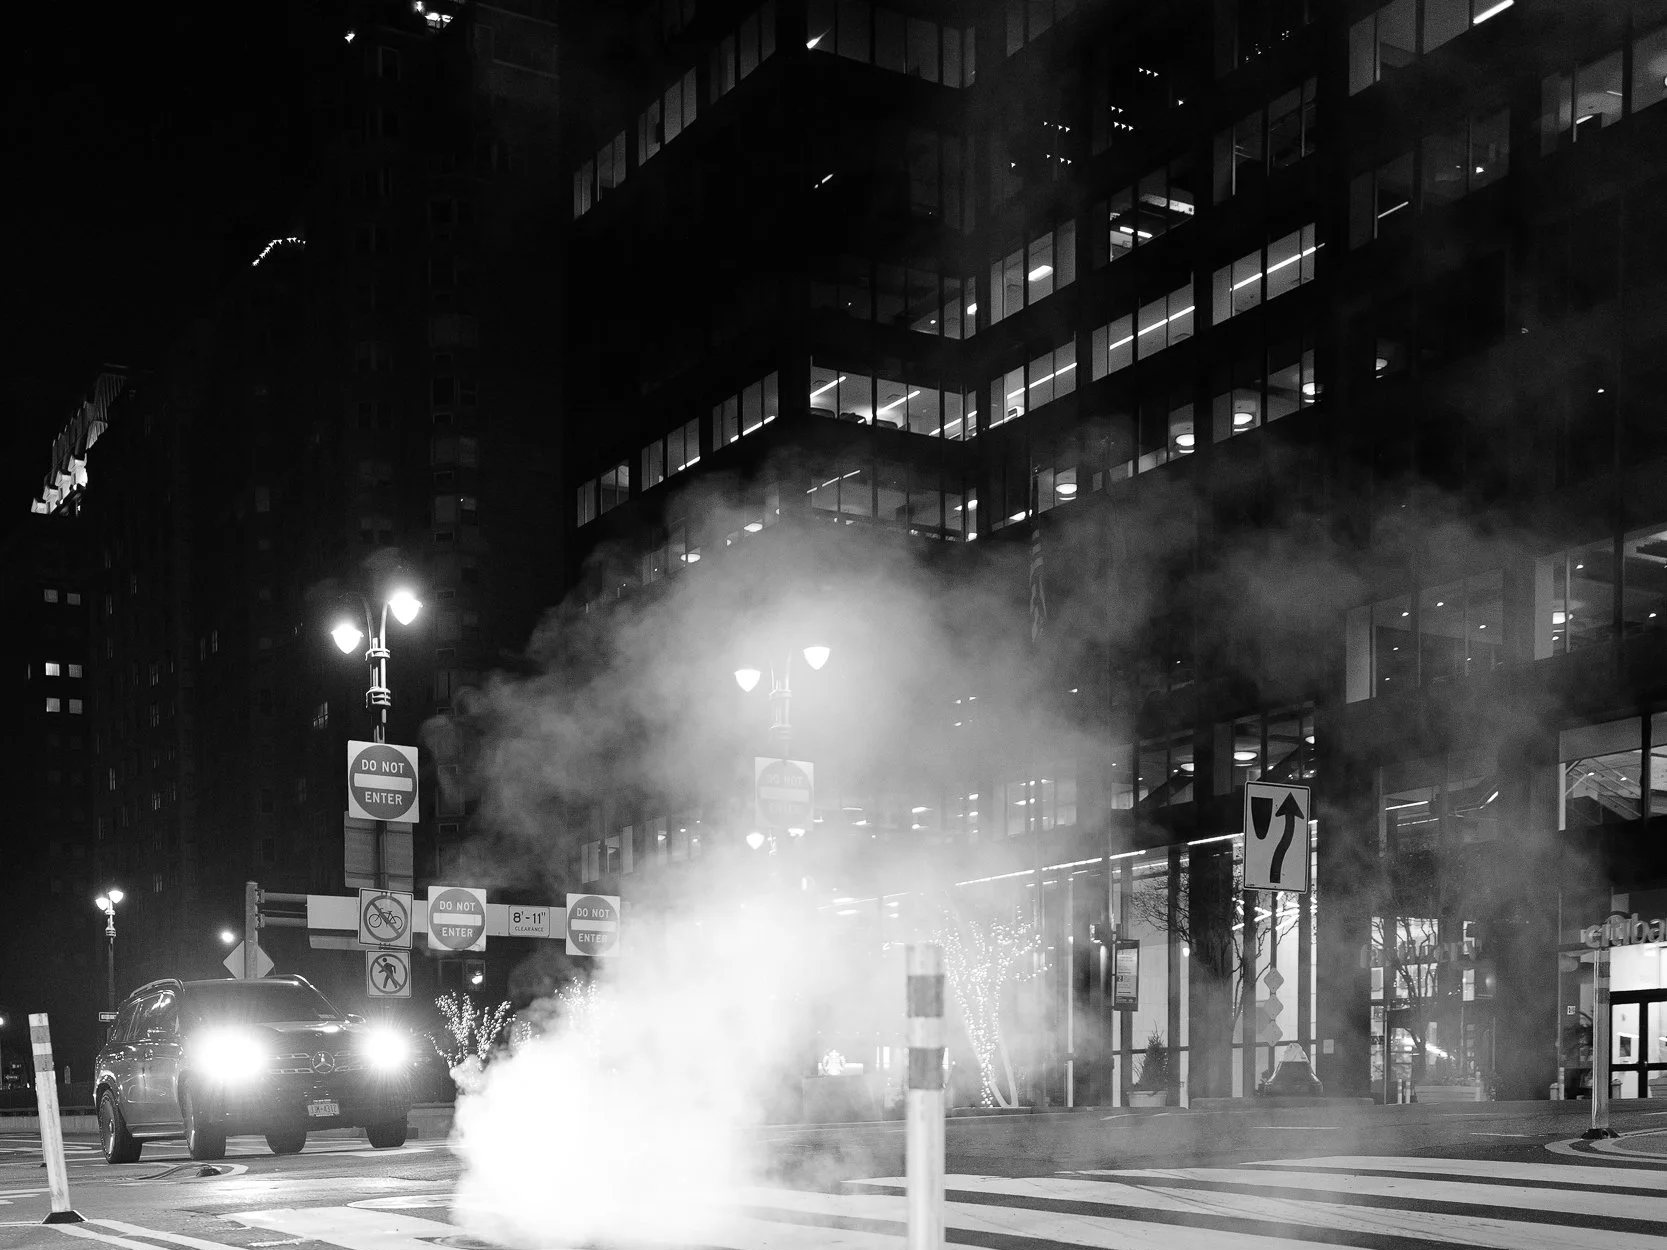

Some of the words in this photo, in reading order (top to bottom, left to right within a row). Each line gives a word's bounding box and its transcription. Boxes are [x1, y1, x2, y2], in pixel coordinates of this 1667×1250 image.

[361, 759, 377, 771] DO
[382, 761, 405, 774] NOT
[766, 774, 780, 784] DO
[784, 775, 804, 787] NOT
[365, 791, 403, 805] ENTER
[439, 901, 453, 911] DO
[456, 902, 476, 912] NOT
[576, 907, 588, 917] DO
[592, 908, 610, 919] NOT
[442, 927, 473, 938] ENTER
[1584, 912, 1667, 948] citiba
[578, 933, 608, 943] ENTER
